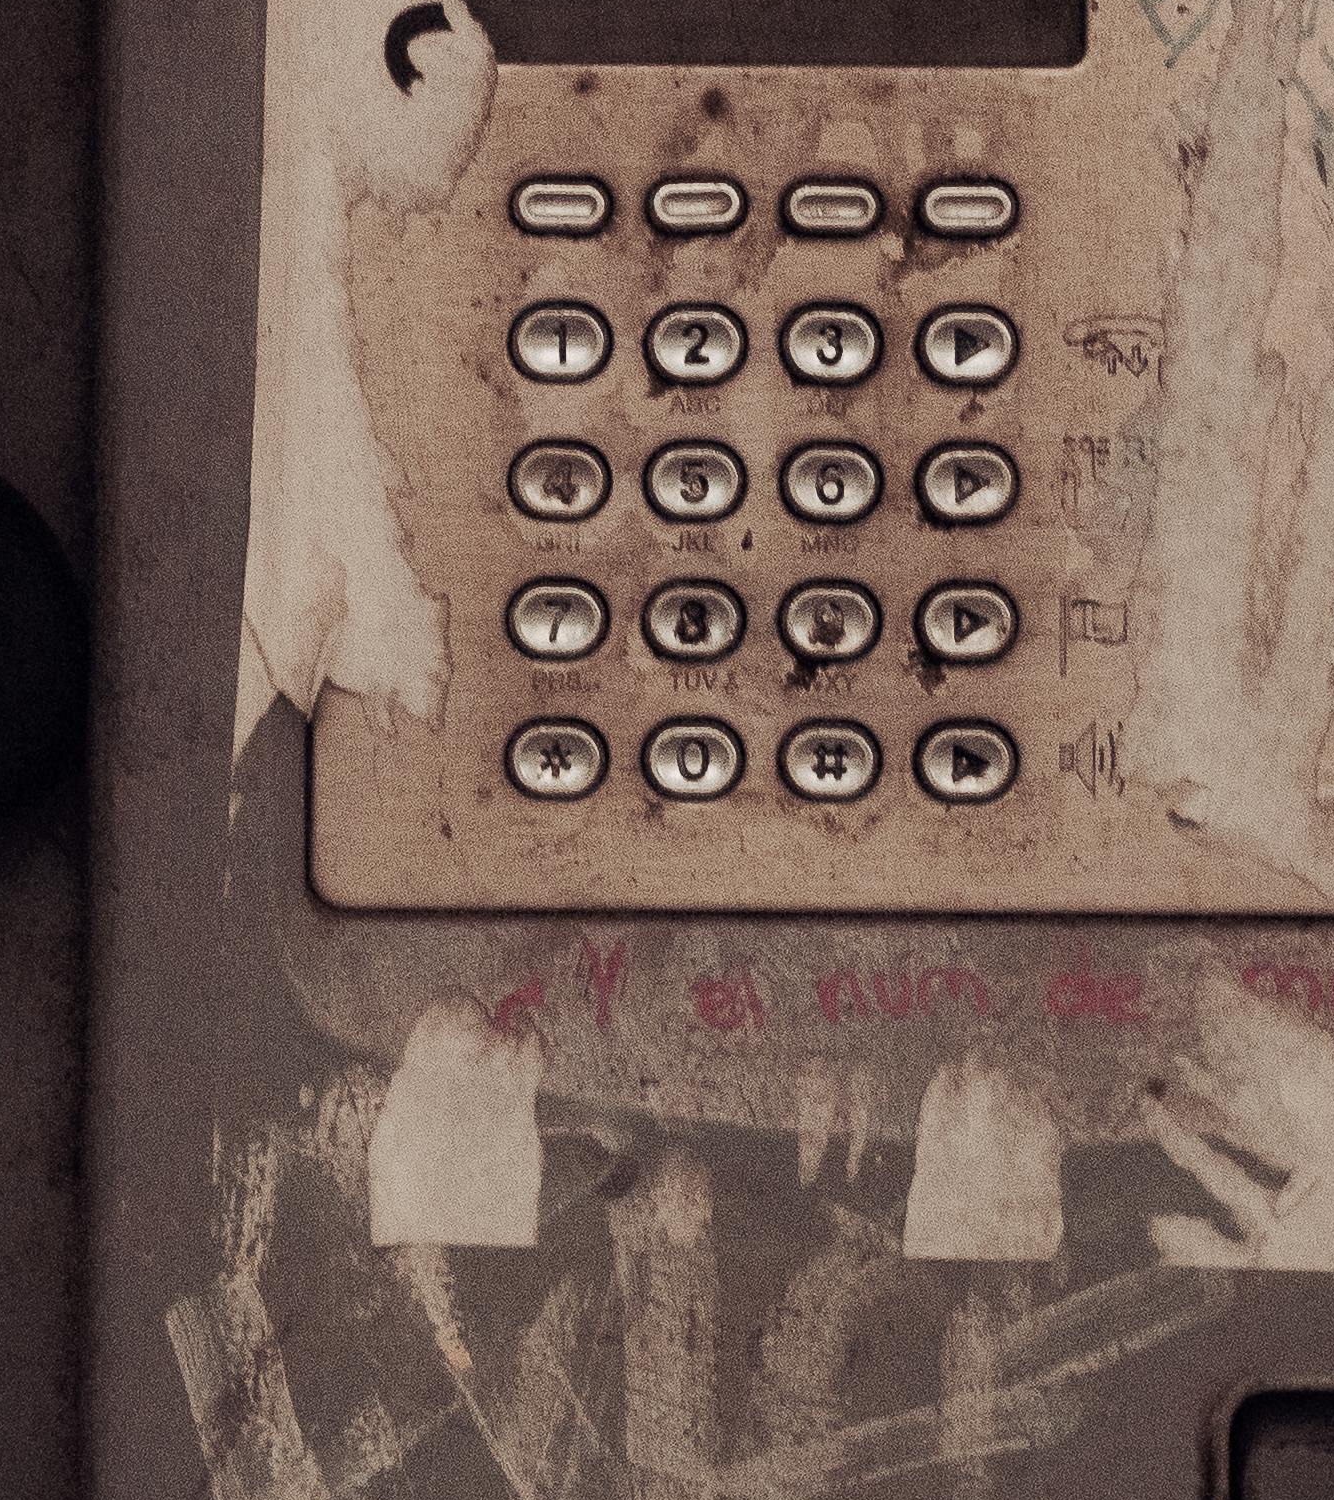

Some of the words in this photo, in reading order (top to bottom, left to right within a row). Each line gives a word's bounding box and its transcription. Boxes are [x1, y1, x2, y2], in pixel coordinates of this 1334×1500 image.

[551, 323, 568, 366] 1
[683, 322, 711, 366] 2
[816, 323, 845, 367] 3
[679, 460, 710, 504] 5
[814, 463, 845, 505] 6
[545, 600, 572, 644] 7
[675, 600, 710, 646] 8
[675, 738, 711, 782] 0
